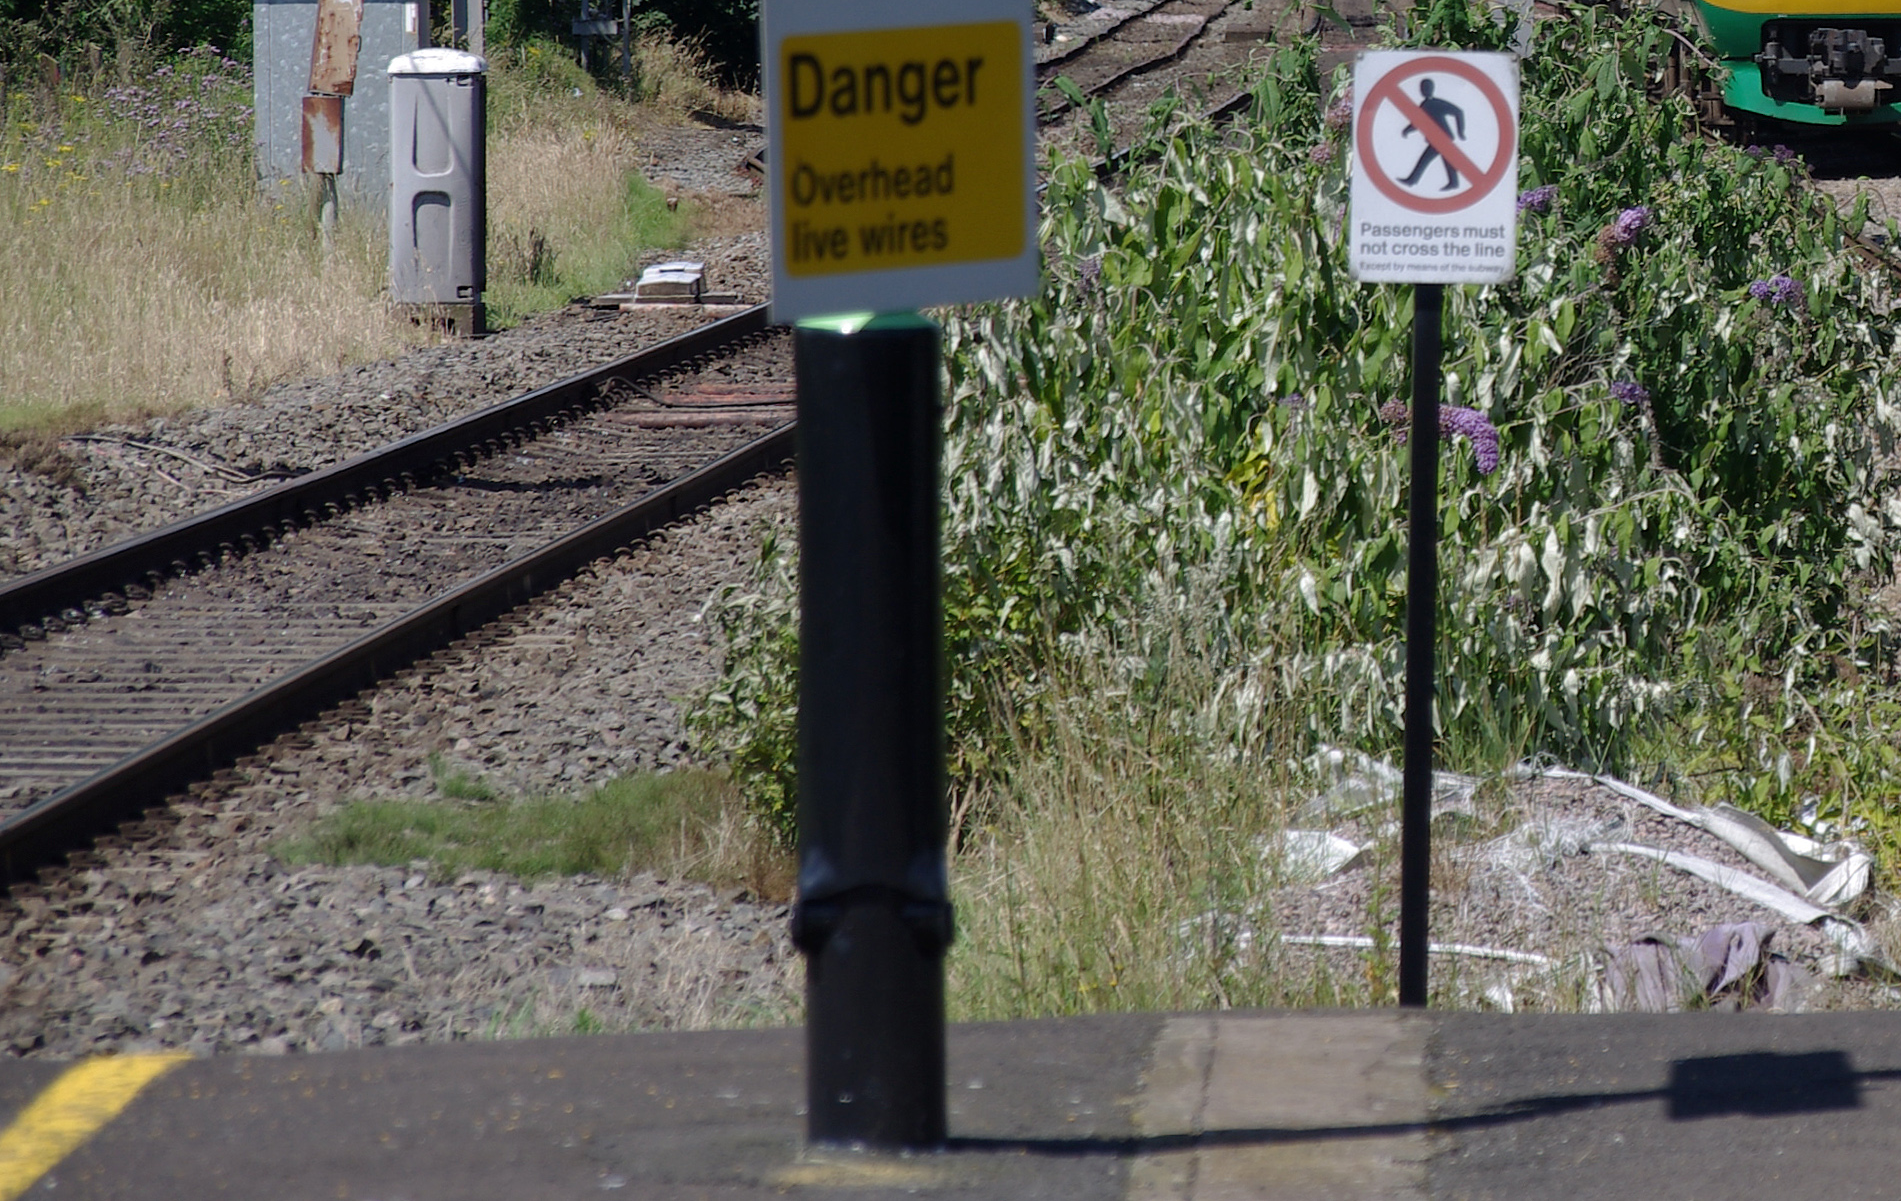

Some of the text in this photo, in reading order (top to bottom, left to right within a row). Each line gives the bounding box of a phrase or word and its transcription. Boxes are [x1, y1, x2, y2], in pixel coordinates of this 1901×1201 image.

[789, 51, 984, 126] Danger
[792, 154, 956, 207] Overhead
[791, 210, 949, 263] live wires
[1360, 222, 1505, 240] Passengers must
[1359, 261, 1391, 271] Except
[1393, 261, 1404, 272] by
[1407, 263, 1438, 271] means
[1440, 262, 1449, 272] of
[1451, 263, 1466, 272] the
[1360, 241, 1505, 258] not cross the line
